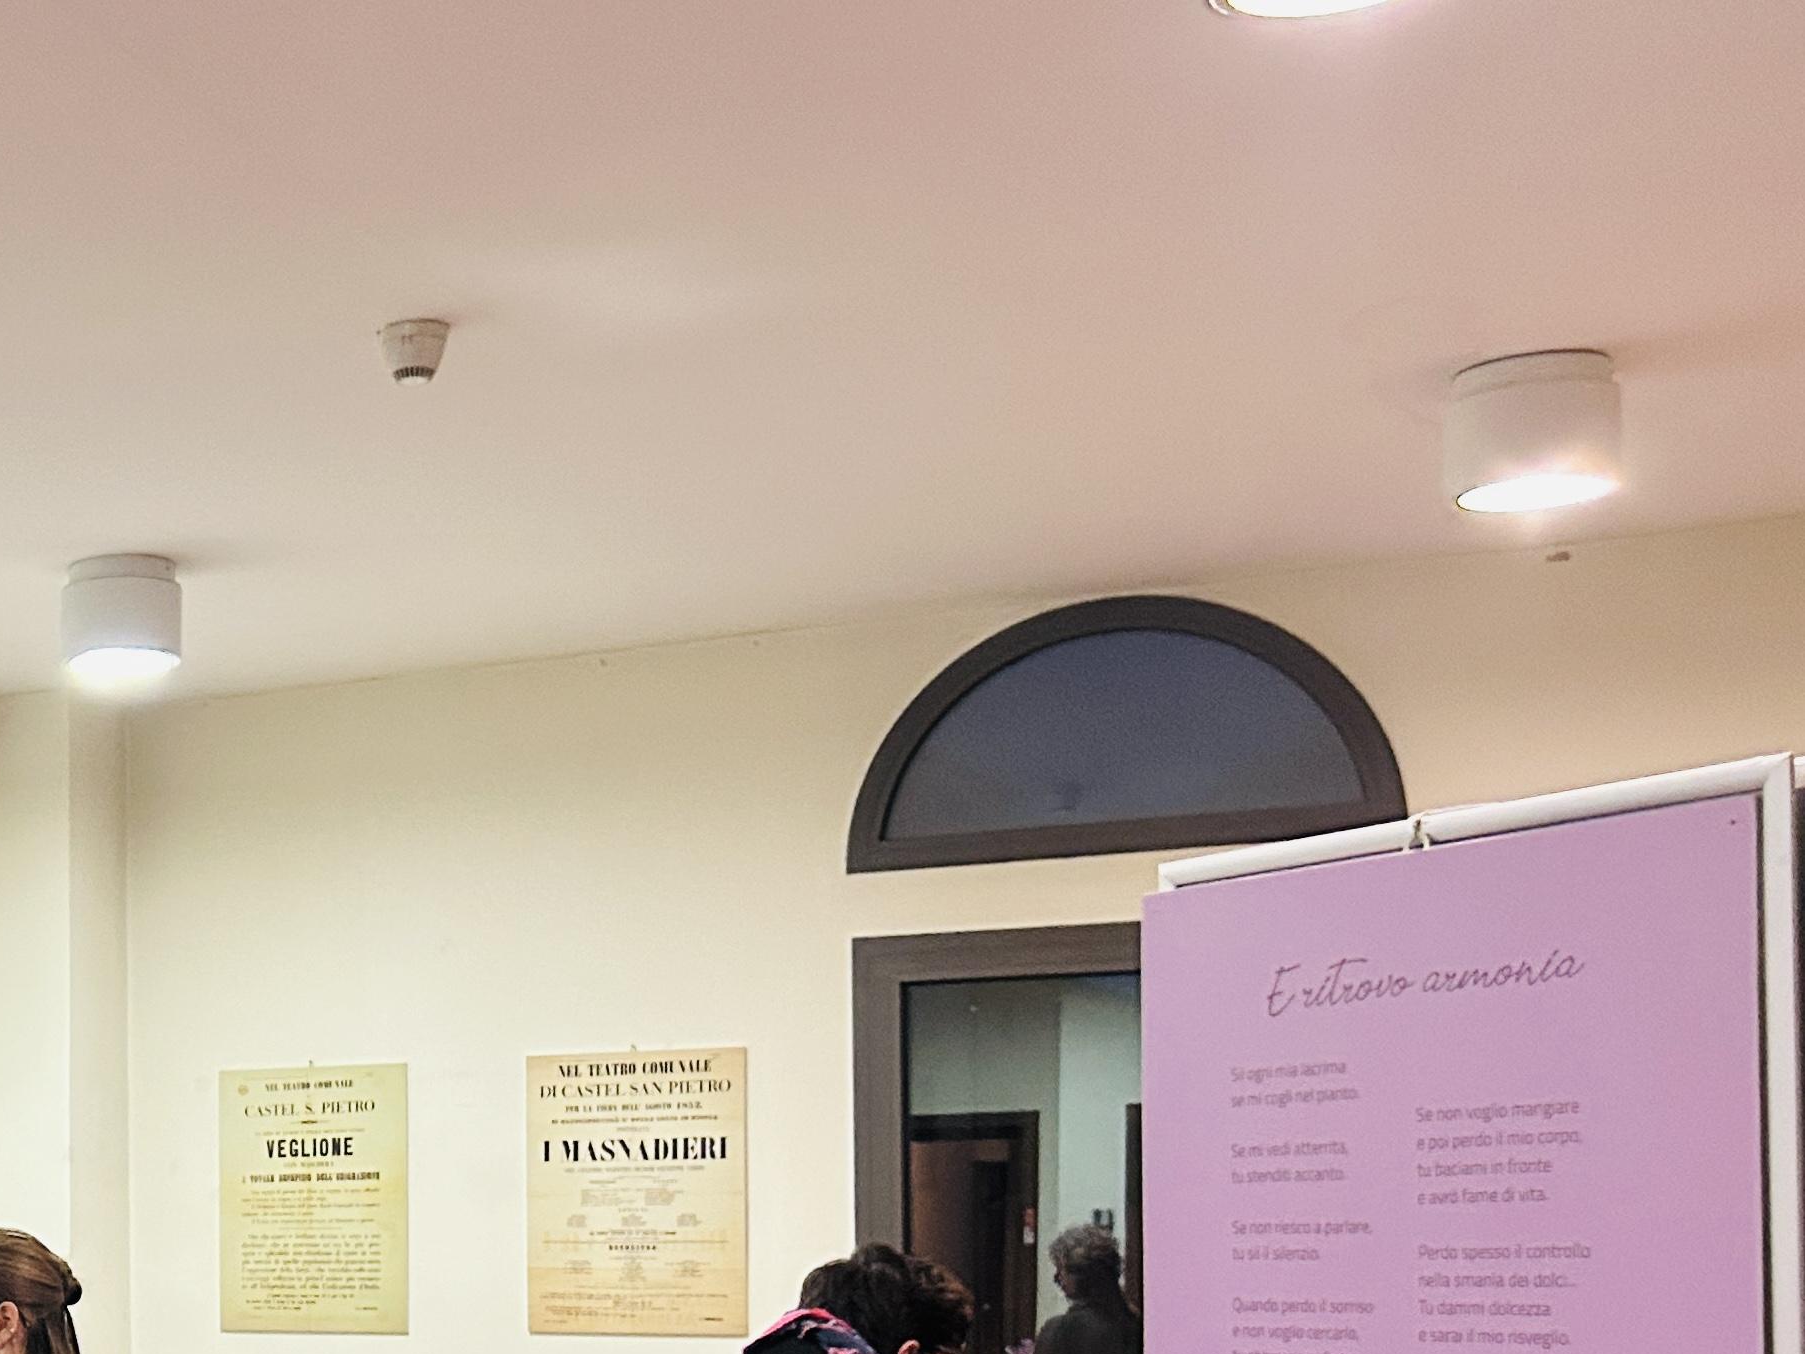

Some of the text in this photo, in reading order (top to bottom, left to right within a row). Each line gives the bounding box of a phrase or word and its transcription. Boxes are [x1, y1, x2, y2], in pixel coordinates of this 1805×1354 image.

[1267, 949, 1586, 1017] E ritrovo armonia
[559, 1058, 713, 1078] NEL TEATRO COMUNALE
[540, 1078, 732, 1099] DI CASTEL SAN PIETRO
[244, 1102, 300, 1118] CASTEL
[321, 1099, 376, 1115] PIETRO
[1416, 1102, 1580, 1123] Se non voglio mangiare
[266, 1136, 355, 1159] VEGLIONE
[543, 1136, 728, 1164] I MASNADIERI
[1417, 1137, 1425, 1150] e
[1452, 1131, 1492, 1149] perdo
[1506, 1132, 1534, 1146] mio
[1507, 1158, 1553, 1174] fronte
[1417, 1192, 1425, 1205] e
[1462, 1188, 1497, 1203] fame
[1500, 1187, 1515, 1203] di
[1231, 1220, 1246, 1235] Se
[1249, 1222, 1271, 1234] non
[1418, 1242, 1591, 1260] Perdo spesso il controllo
[1418, 1272, 1450, 1288] nella
[1232, 1297, 1278, 1314] Quando
[1281, 1299, 1317, 1316] perdo
[1418, 1299, 1552, 1317] Tu dammi dolcezza
[1243, 1326, 1264, 1338] non
[1268, 1325, 1305, 1342] voglio
[1418, 1329, 1427, 1342] e
[1477, 1330, 1505, 1344] mio
